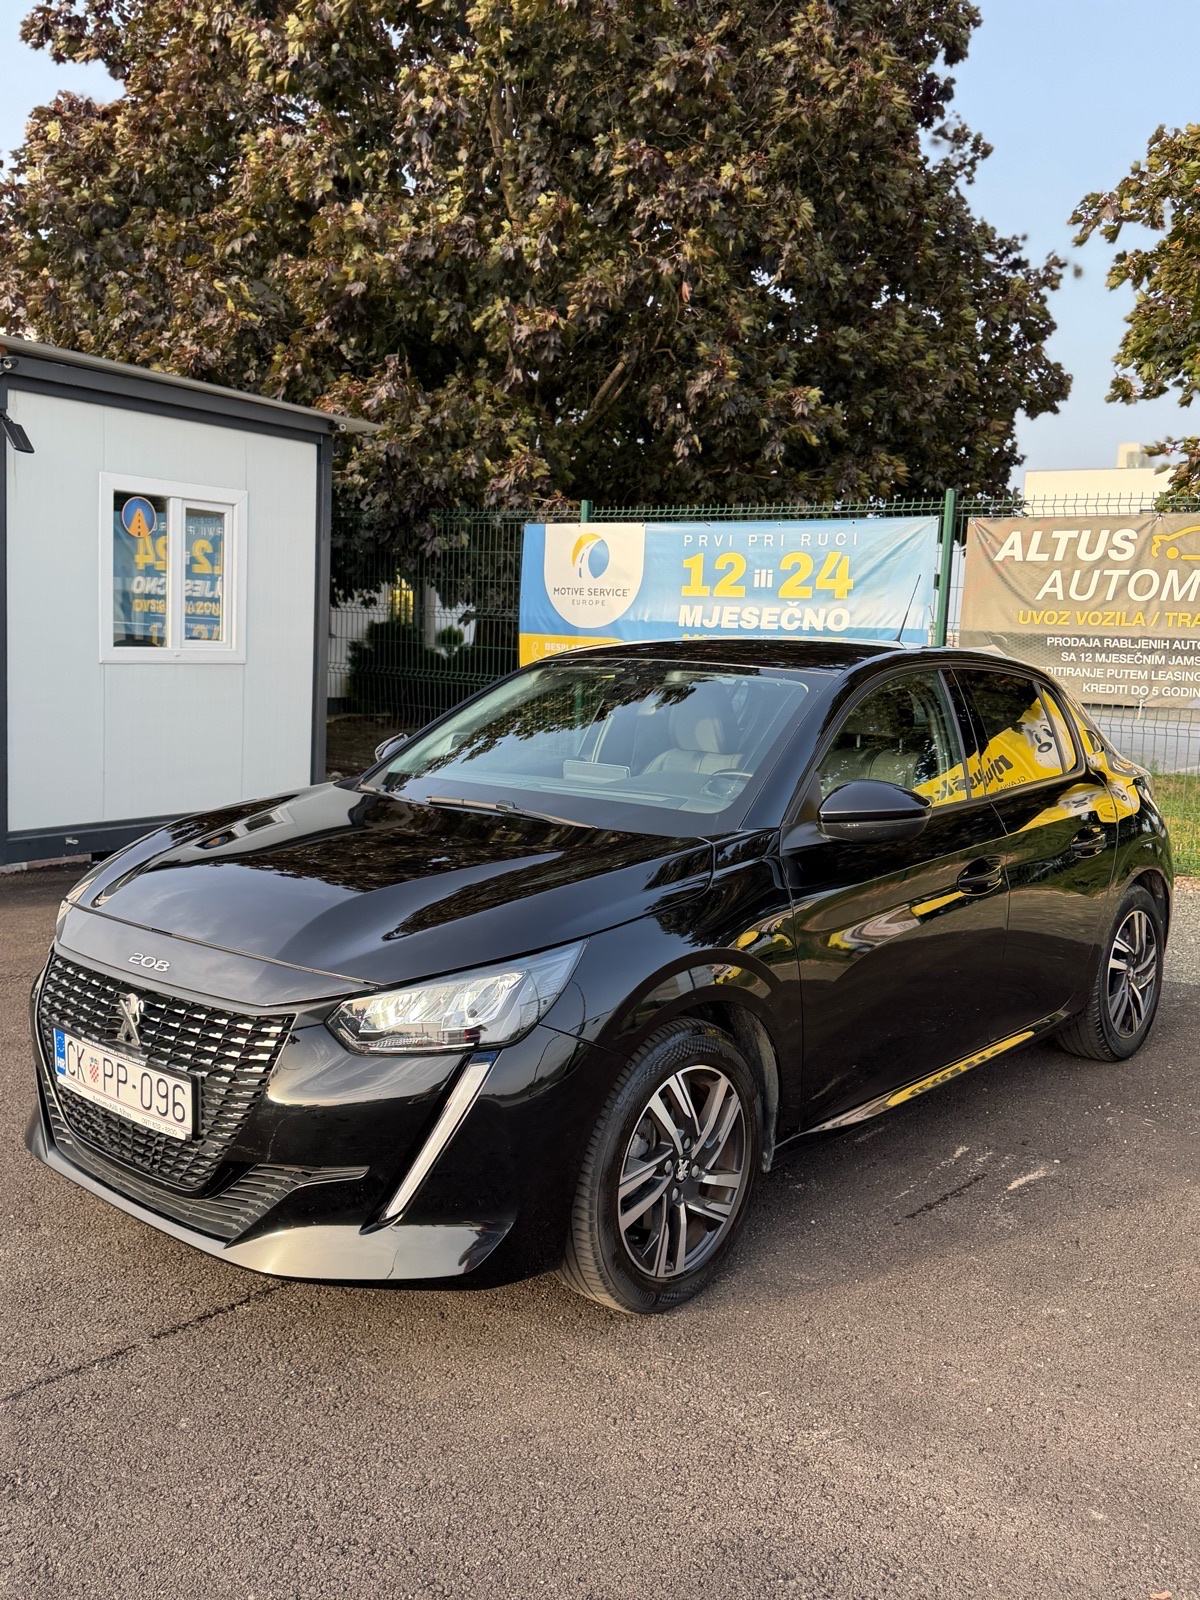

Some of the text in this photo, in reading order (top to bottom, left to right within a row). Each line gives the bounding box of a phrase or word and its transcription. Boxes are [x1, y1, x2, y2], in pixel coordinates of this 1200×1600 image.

[684, 532, 857, 547] PRVI PRI RUCI
[993, 529, 1138, 562] ALTUS
[681, 551, 854, 600] 12 ili 24
[553, 587, 628, 597] MOTIVE SERVICE
[1035, 568, 1200, 602] AUTOM
[678, 601, 851, 632] MJESEČNO
[1018, 610, 1071, 625] UVOZ
[1075, 611, 1145, 627] VOZILA
[1149, 612, 1160, 627] /
[1046, 637, 1101, 648] PRODAJA
[1103, 638, 1170, 649] RABLJENIH
[1061, 652, 1077, 662] SA
[1079, 653, 1092, 662] 12
[1095, 652, 1166, 665] MJESEČNIM
[1106, 668, 1148, 680] PUTEM
[1082, 683, 1127, 694] KREDITI
[1131, 685, 1149, 696] DO
[1151, 686, 1159, 696] 5
[128, 952, 170, 972] 208
[103, 1057, 186, 1123] PP-096
